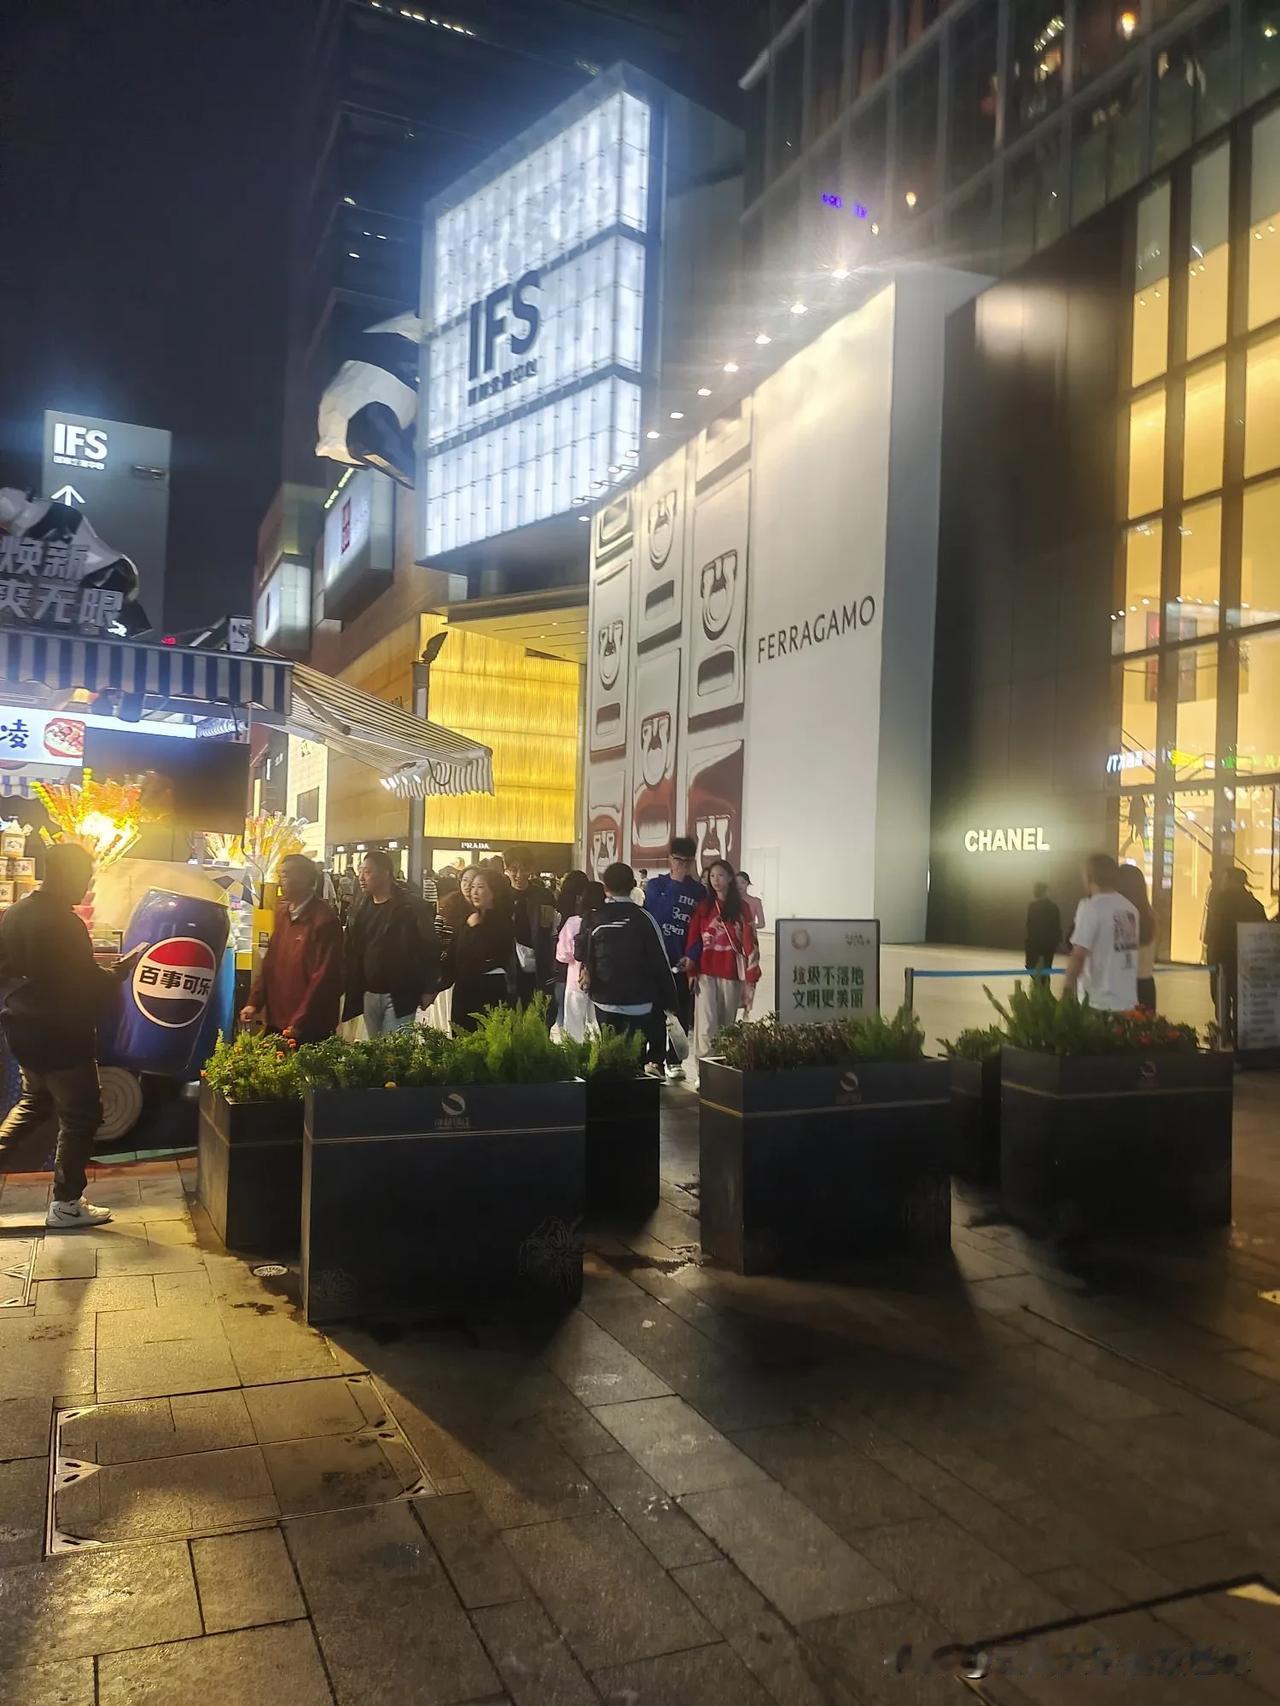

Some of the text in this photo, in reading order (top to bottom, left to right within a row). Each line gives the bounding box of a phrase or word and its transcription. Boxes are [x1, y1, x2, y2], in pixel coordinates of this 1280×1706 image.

[469, 270, 541, 381] IFS
[53, 423, 108, 460] IFS
[757, 595, 876, 664] FERRAGAMO
[964, 827, 1050, 852] CHANEL
[138, 965, 213, 996] 百事可乐
[792, 965, 864, 986] 垃圾不落地
[792, 989, 864, 1010] 文明更美丽
